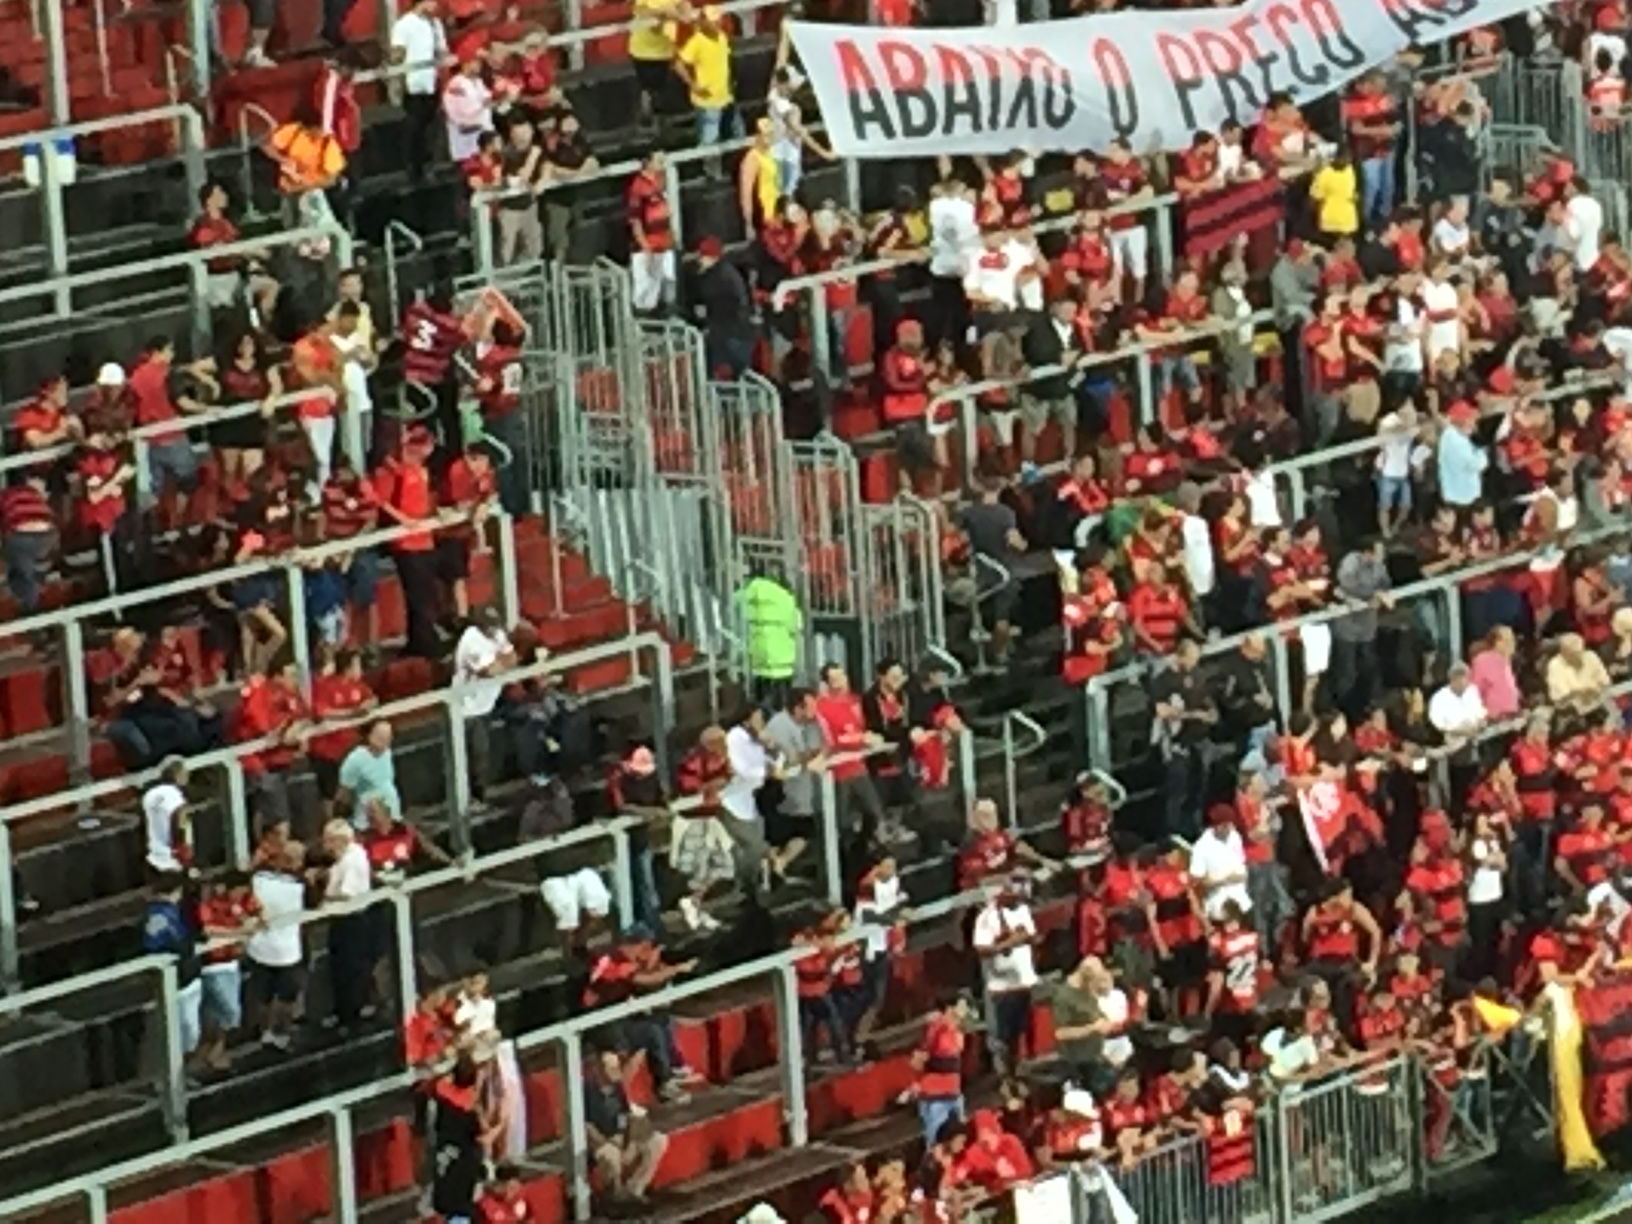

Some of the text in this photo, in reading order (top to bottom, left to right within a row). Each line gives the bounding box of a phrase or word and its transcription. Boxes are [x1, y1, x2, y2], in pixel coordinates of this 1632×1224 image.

[834, 40, 1077, 141] ABAIXO
[1091, 37, 1139, 138] O
[410, 319, 438, 351] 3
